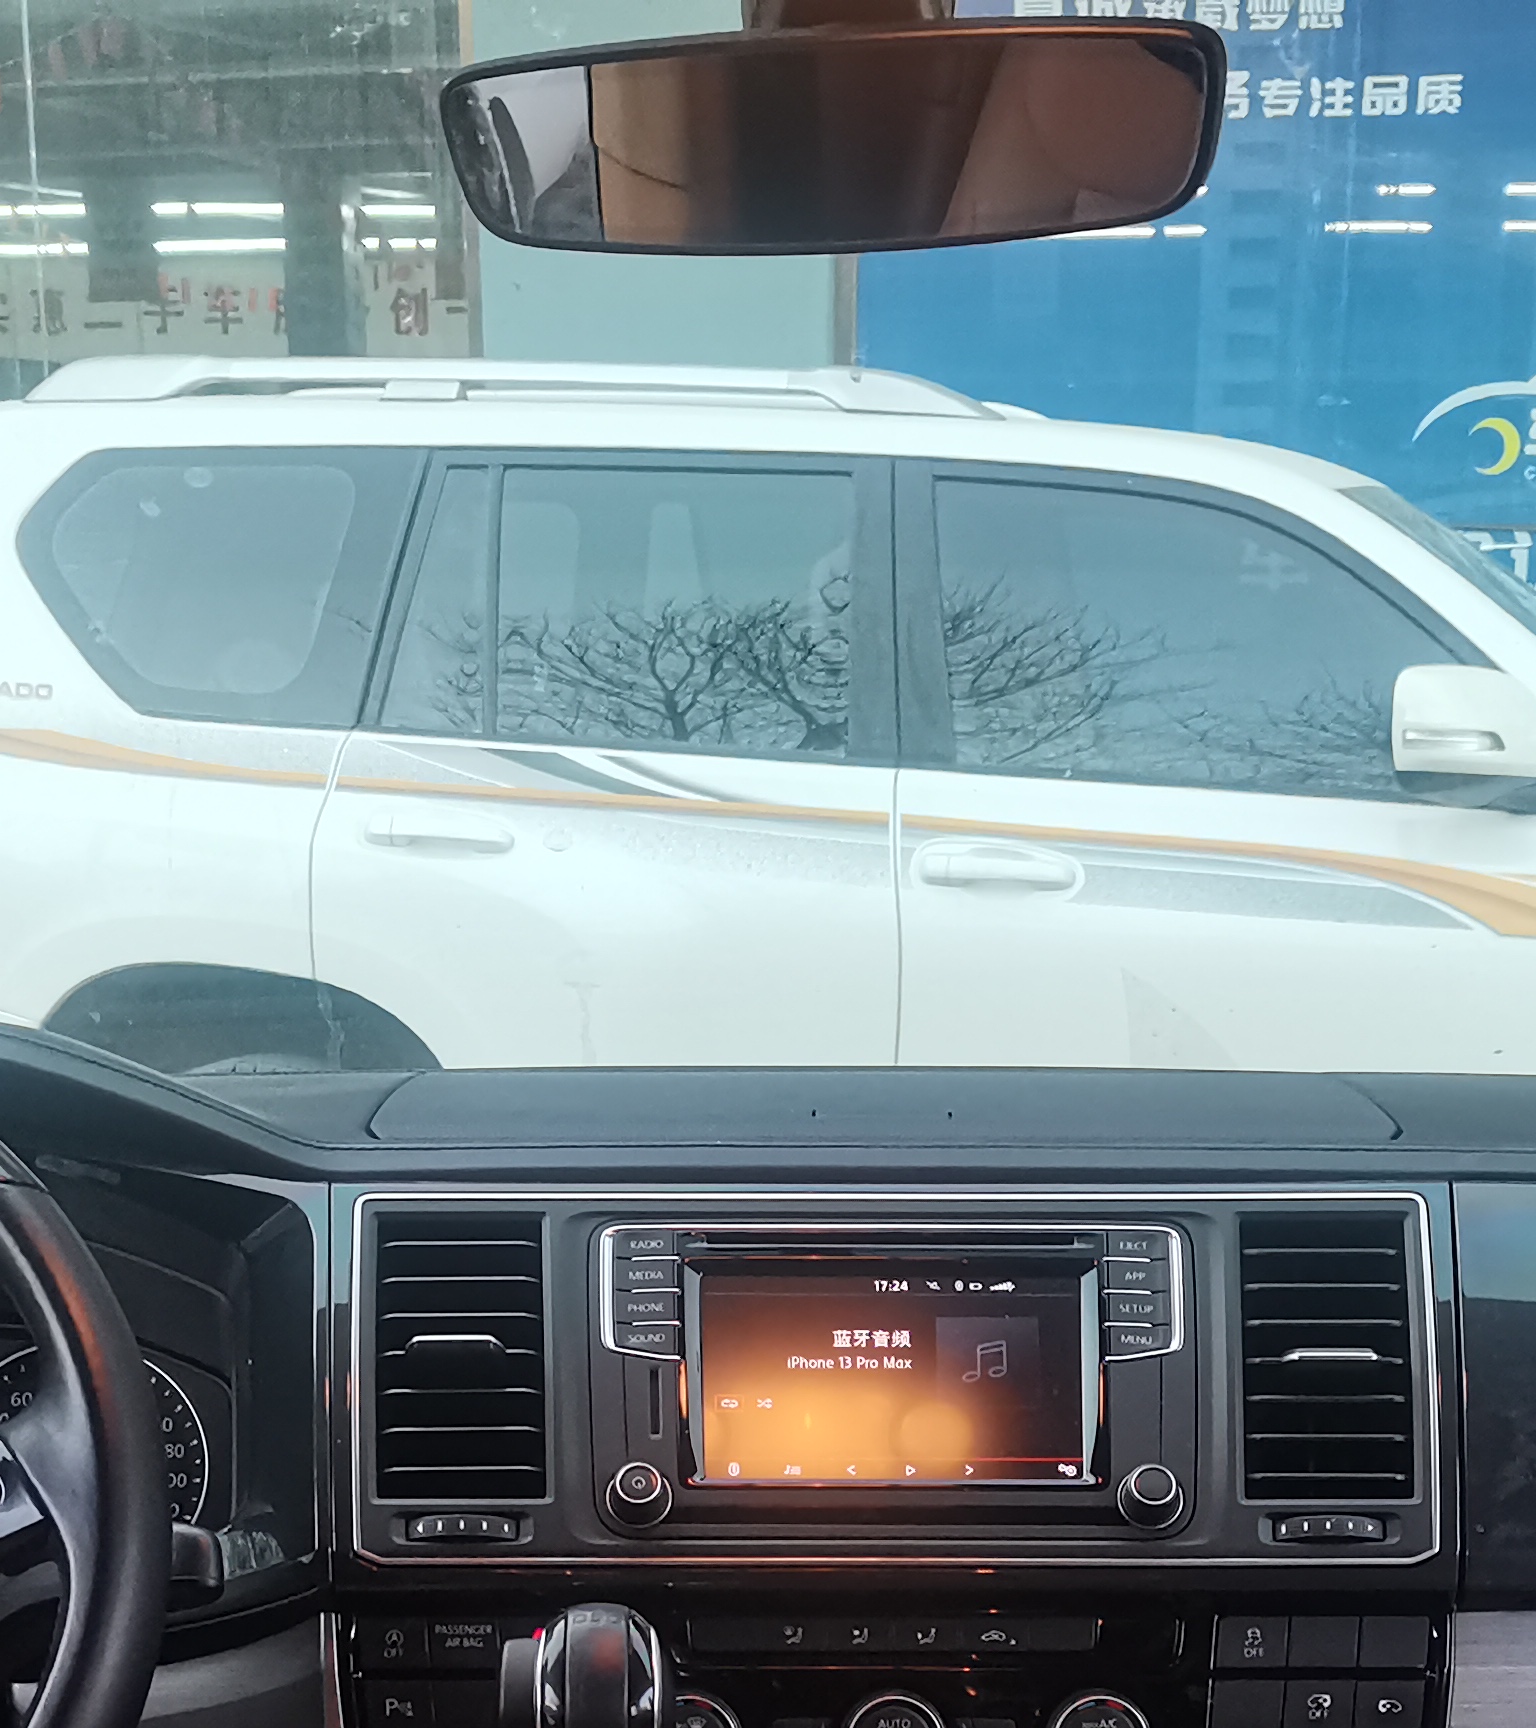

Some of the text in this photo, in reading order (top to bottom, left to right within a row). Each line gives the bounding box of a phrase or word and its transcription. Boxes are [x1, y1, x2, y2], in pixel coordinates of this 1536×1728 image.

[630, 1240, 664, 1250] RADIO
[628, 1270, 664, 1281] MEDIA
[1124, 1271, 1146, 1281] APP
[874, 1280, 909, 1292] 17:24
[627, 1303, 665, 1313] PHONE
[1119, 1303, 1154, 1314] SETUP
[627, 1333, 666, 1344] SOUND
[832, 1329, 912, 1349] 蓝牙音频
[1120, 1333, 1153, 1345] MENU
[787, 1355, 913, 1370] iPhone 13 Pro Max
[435, 1625, 493, 1634] PASSENGER
[1243, 1648, 1264, 1658] OFF
[1308, 1709, 1329, 1719] OFF
